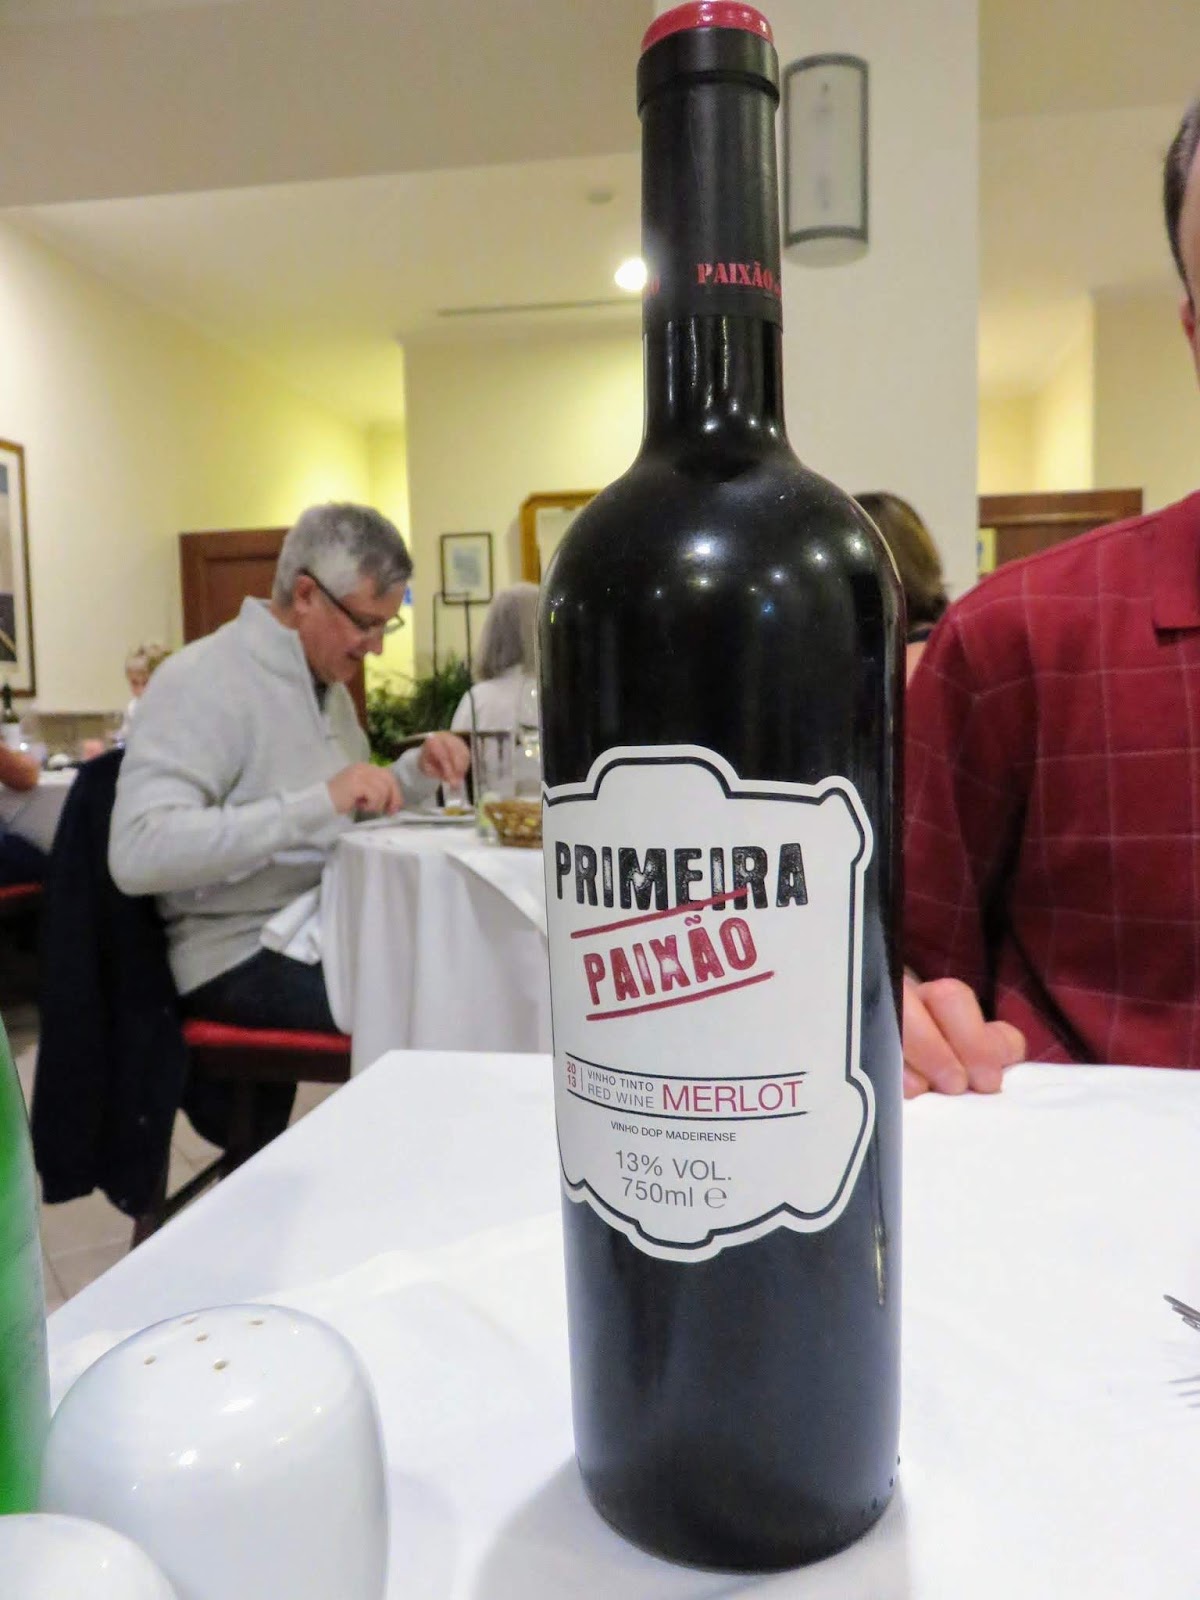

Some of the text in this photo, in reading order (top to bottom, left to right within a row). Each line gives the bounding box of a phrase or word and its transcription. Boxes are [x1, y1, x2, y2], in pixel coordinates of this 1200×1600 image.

[697, 260, 773, 290] PAIXÃO
[555, 841, 808, 911] PRIMEIRA
[583, 914, 757, 1005] PAIXÃO
[566, 1061, 577, 1075] 20
[567, 1074, 578, 1088] 13
[587, 1069, 654, 1092] VINHO TINTO
[587, 1083, 654, 1109] RED WINE
[662, 1080, 803, 1113] MERLOT
[611, 1121, 736, 1142] VINHO DOP MADEIRENSE
[615, 1150, 732, 1181] 13% VOL.
[620, 1176, 694, 1207] 750ml
